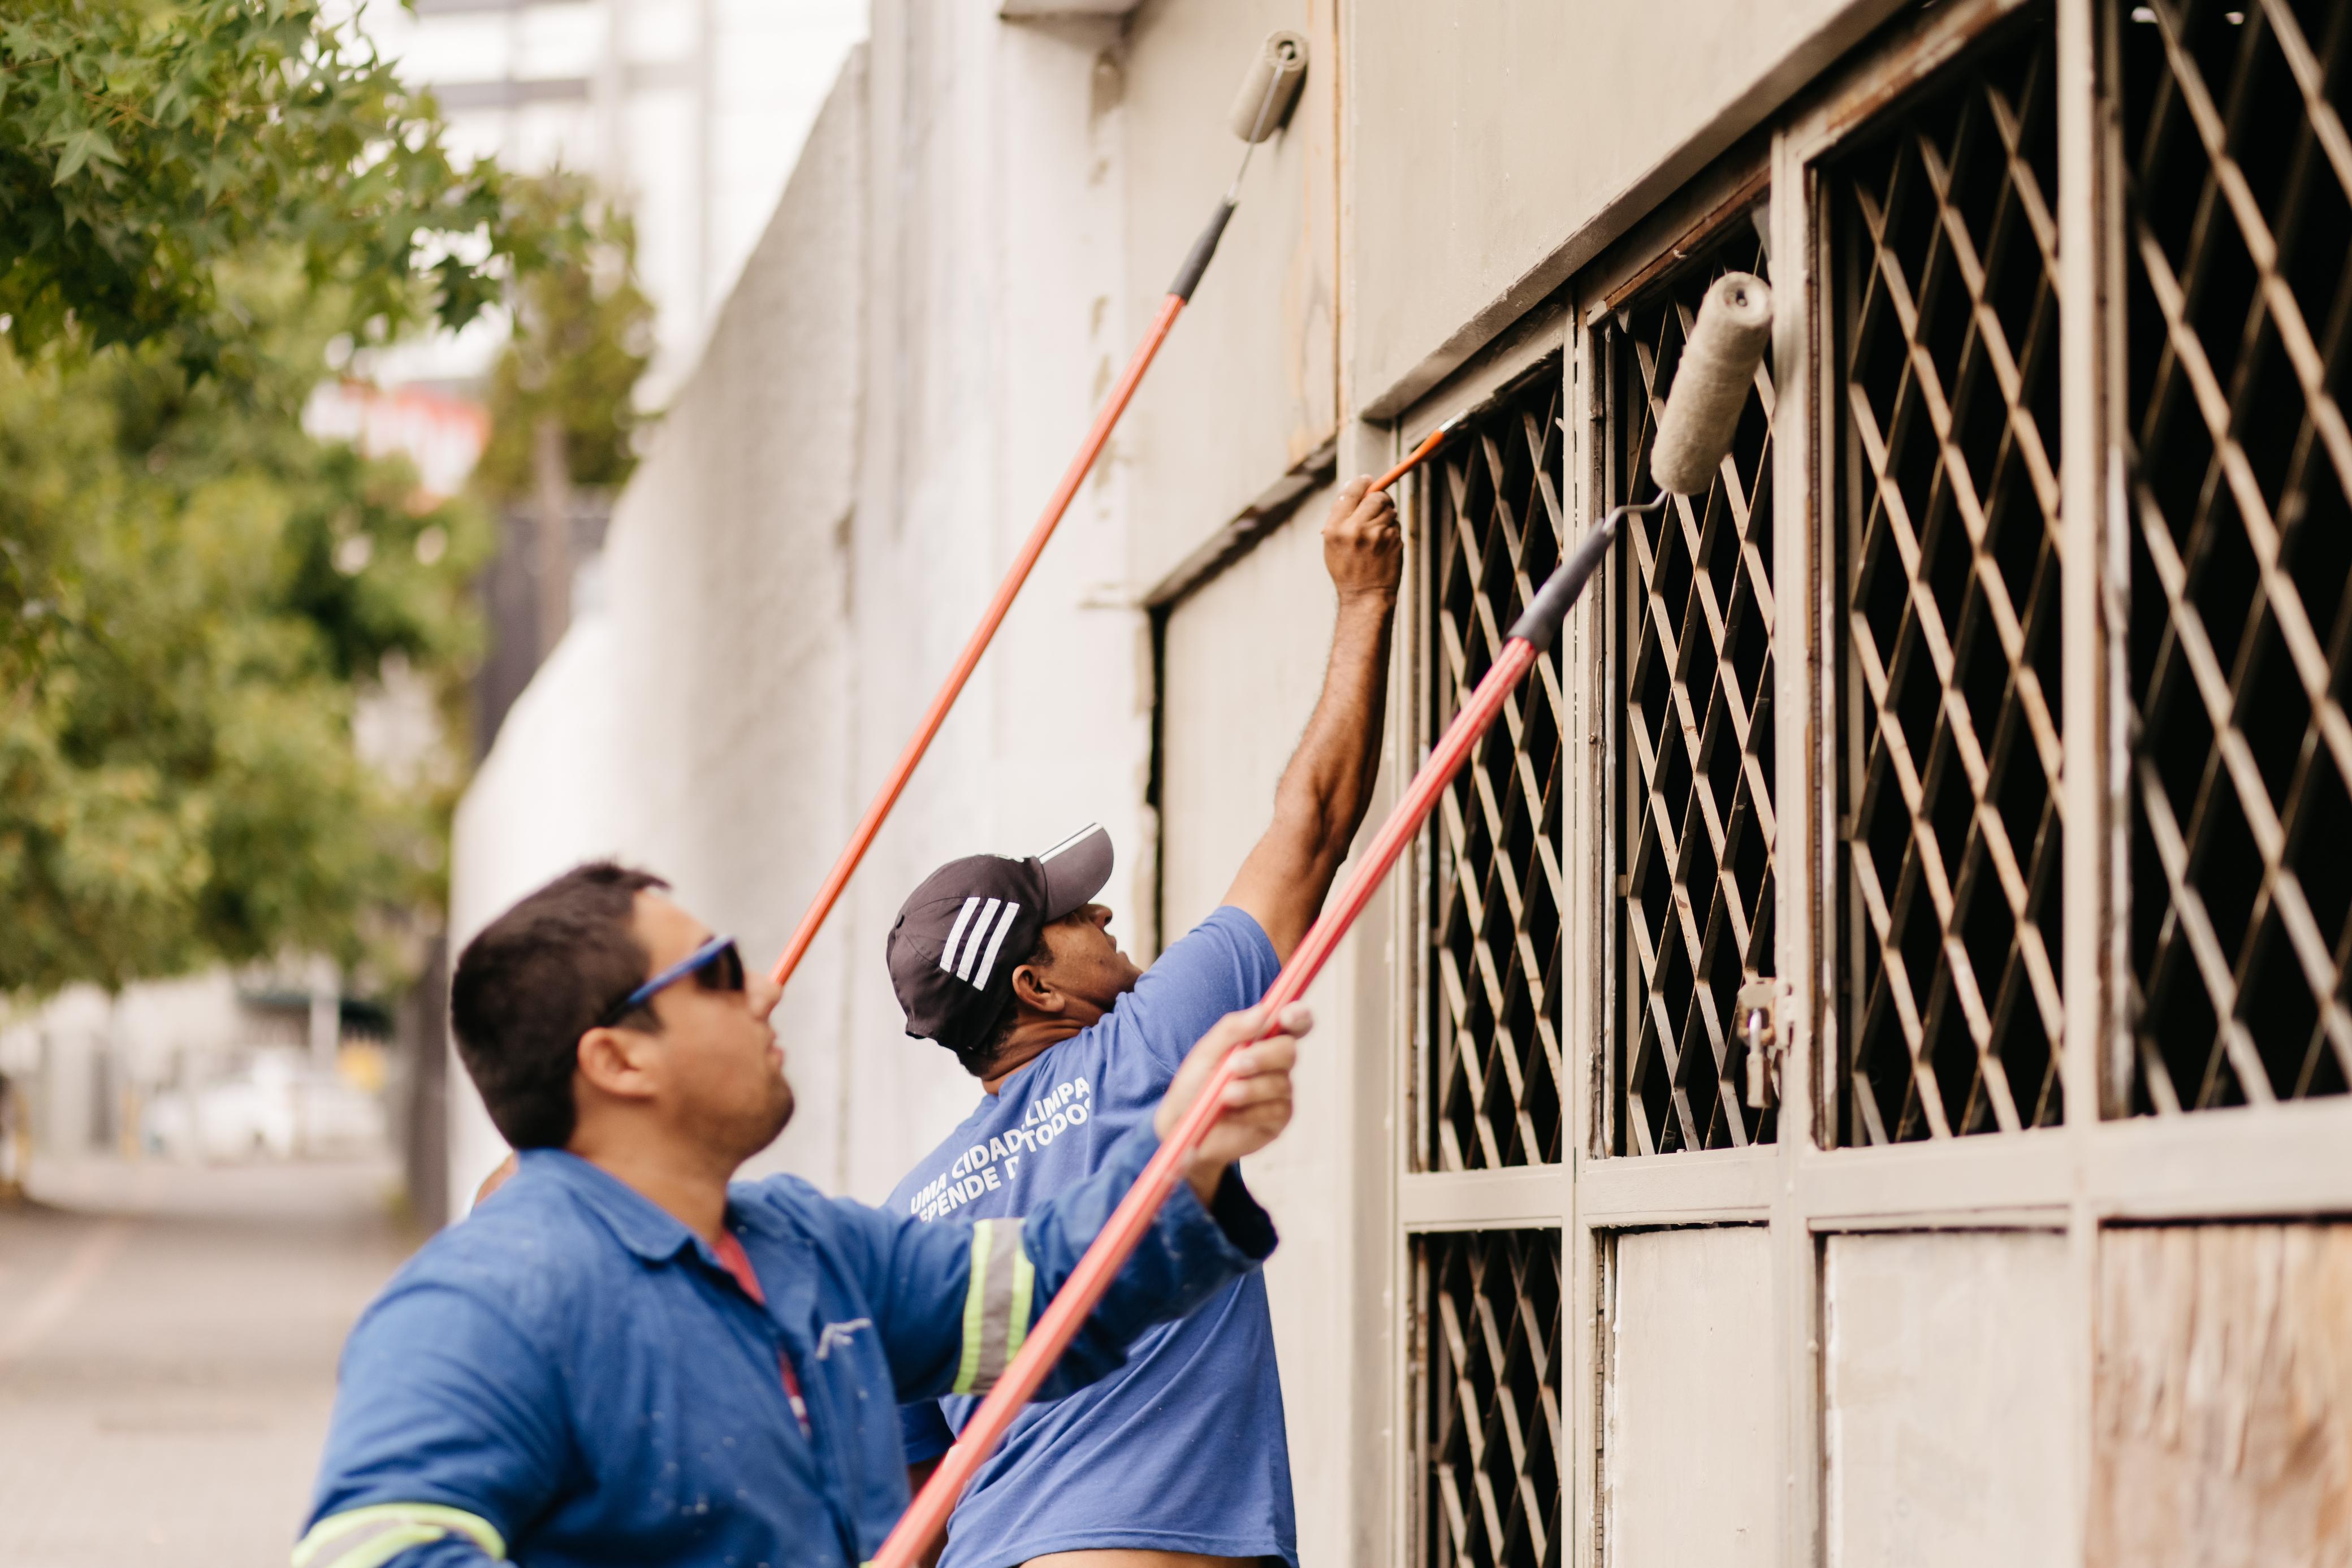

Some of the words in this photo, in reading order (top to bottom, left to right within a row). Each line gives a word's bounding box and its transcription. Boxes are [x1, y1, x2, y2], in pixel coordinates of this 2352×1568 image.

[911, 1172, 946, 1214] UMA
[952, 1124, 1025, 1179] CIDAD
[1025, 1077, 1090, 1127] LIMPA
[919, 1166, 1001, 1223] EPENDE
